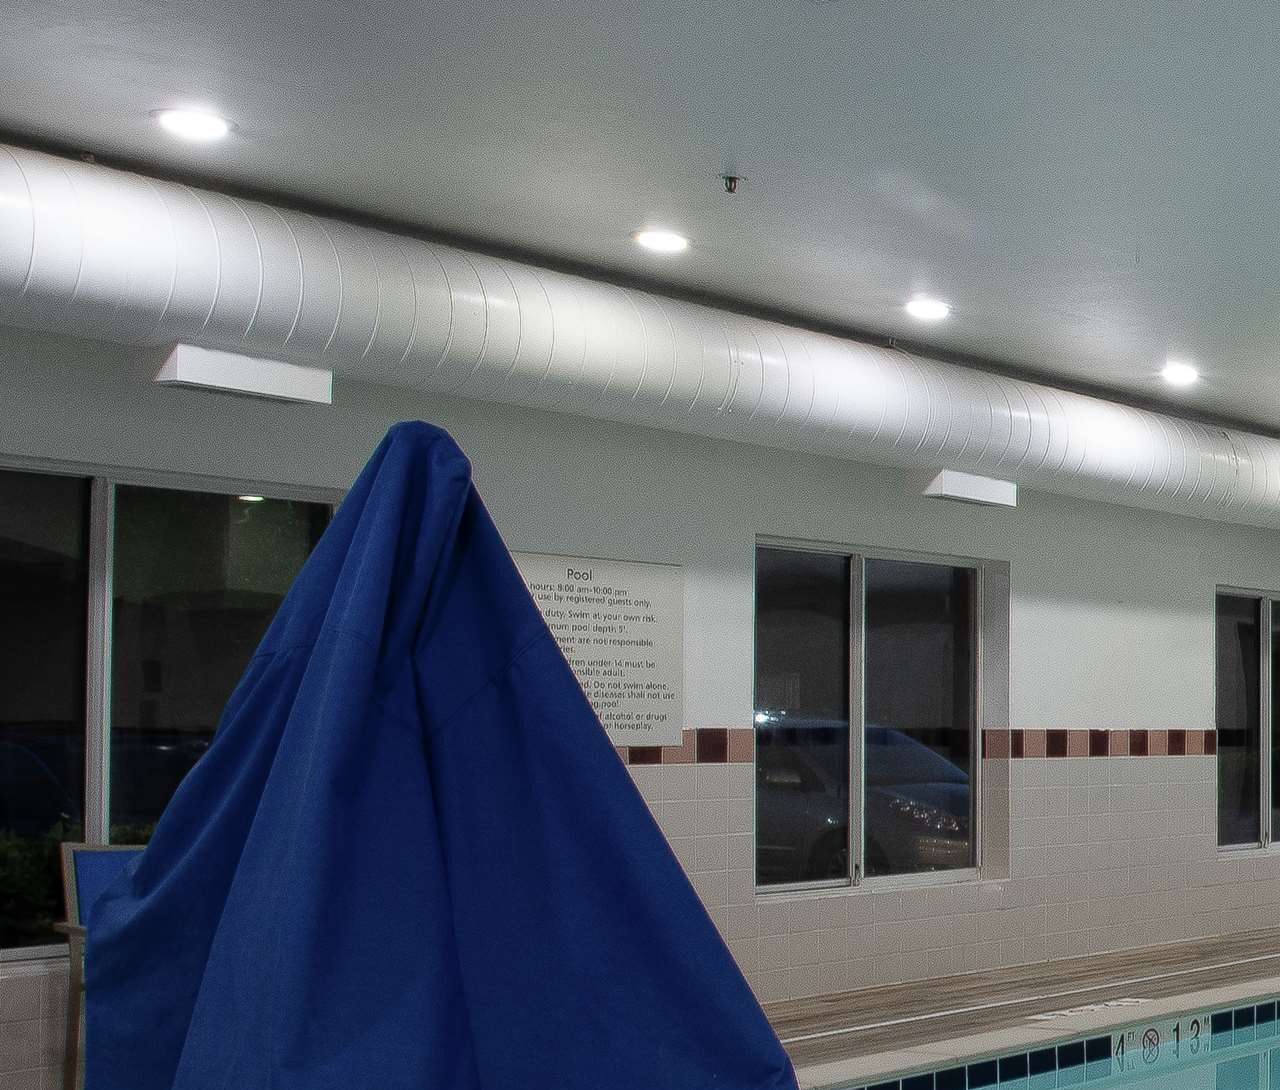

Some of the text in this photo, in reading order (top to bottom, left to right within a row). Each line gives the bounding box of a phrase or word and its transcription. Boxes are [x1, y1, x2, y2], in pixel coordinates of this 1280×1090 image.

[566, 568, 593, 581] Pool
[557, 583, 575, 593] 8:00
[614, 589, 628, 598] pm
[554, 593, 564, 604] by
[566, 595, 605, 605] registered
[607, 598, 632, 608] guests
[568, 610, 590, 619] Swim
[608, 637, 654, 648] responsible
[587, 659, 611, 668] under
[624, 660, 645, 669] must
[646, 659, 656, 669] be
[593, 680, 605, 689] Do
[607, 681, 621, 690] not
[623, 681, 644, 690] swim
[593, 690, 625, 699] diseases
[627, 691, 645, 699] shall
[647, 691, 661, 700] not
[604, 711, 634, 721] alcohol
